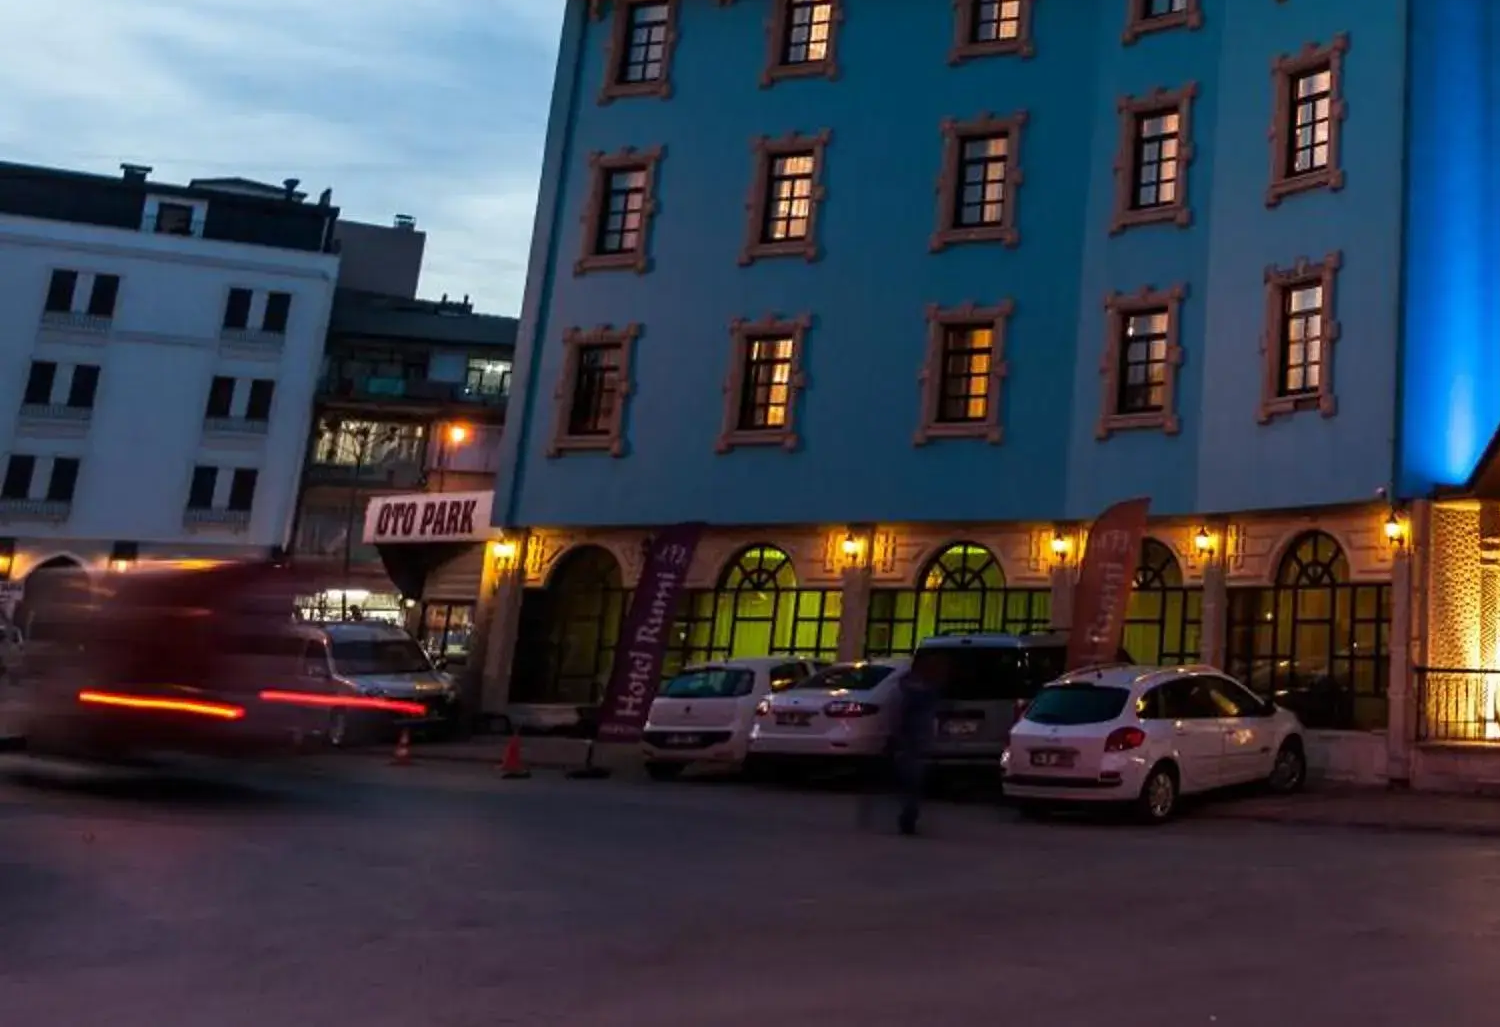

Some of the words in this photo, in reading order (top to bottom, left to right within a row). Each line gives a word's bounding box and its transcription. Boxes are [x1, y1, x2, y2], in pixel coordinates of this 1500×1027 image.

[377, 502, 418, 535] OTO
[419, 500, 477, 535] PARK
[615, 651, 654, 717] Hotel
[636, 571, 677, 644] Rumi
